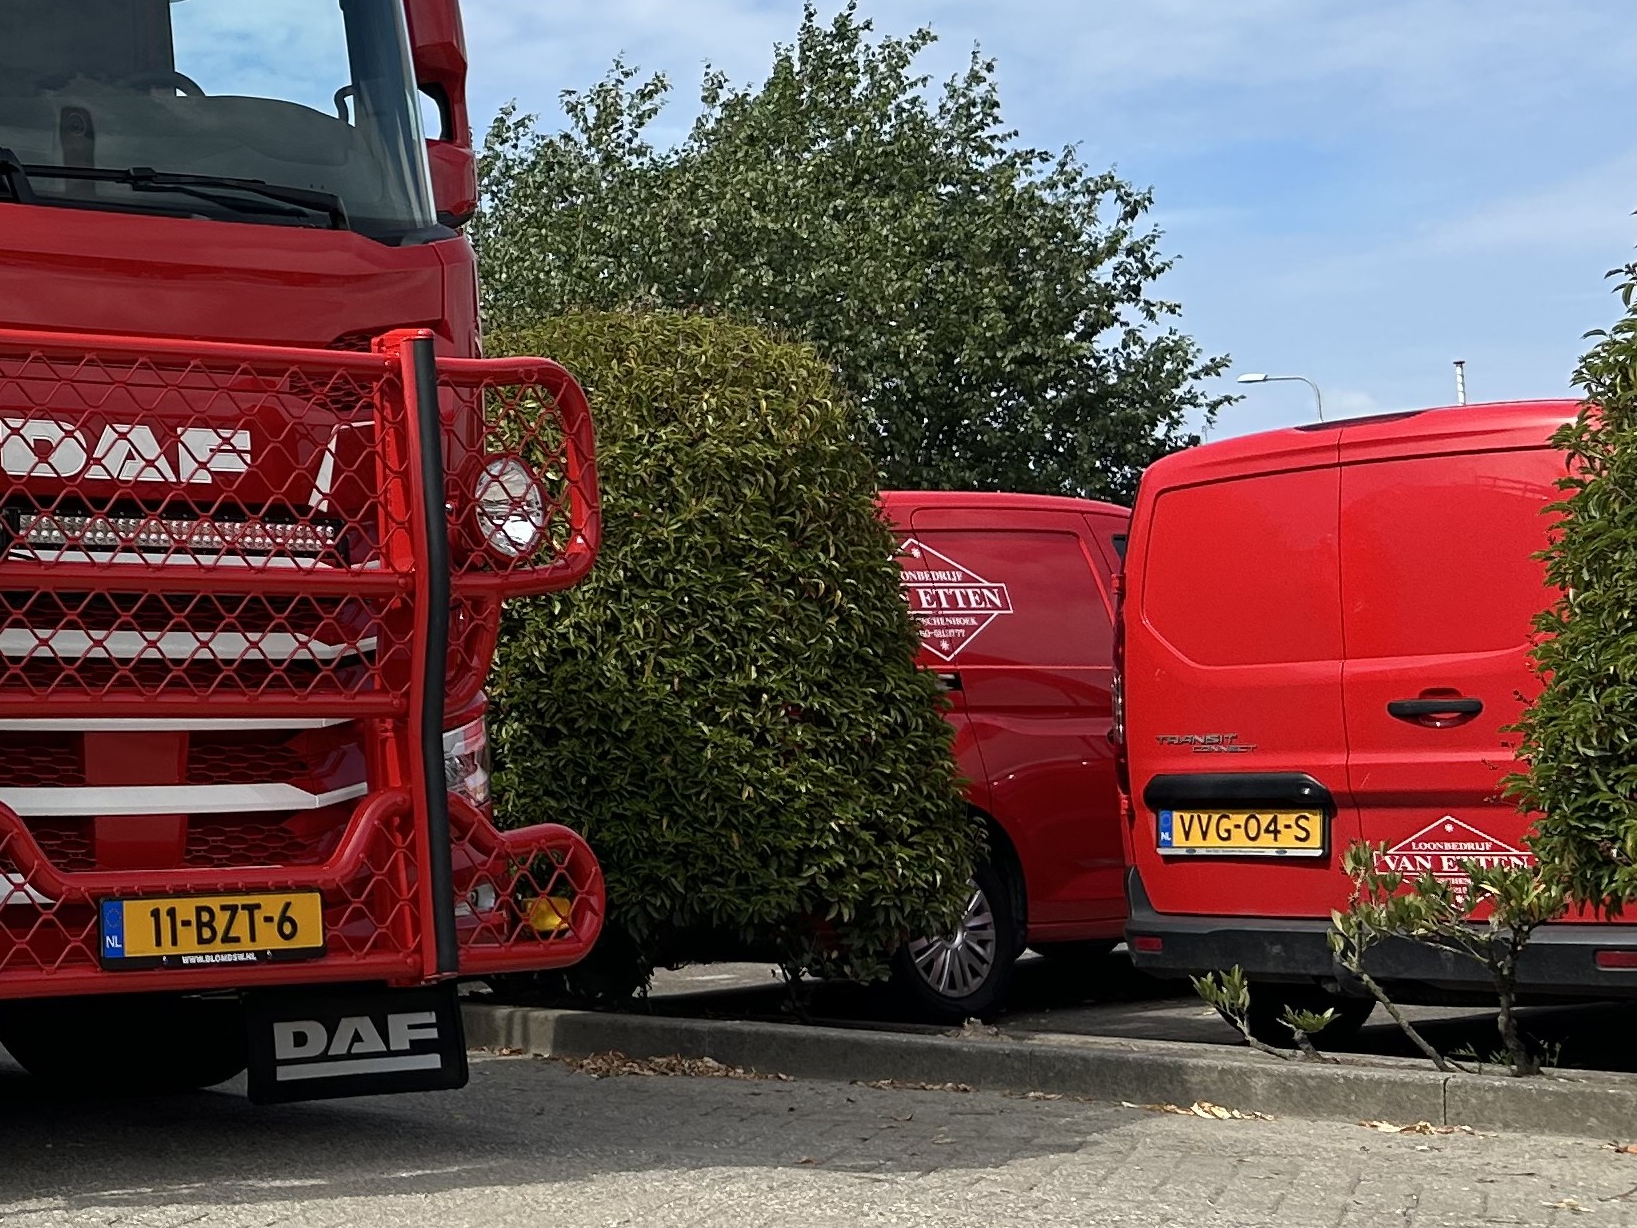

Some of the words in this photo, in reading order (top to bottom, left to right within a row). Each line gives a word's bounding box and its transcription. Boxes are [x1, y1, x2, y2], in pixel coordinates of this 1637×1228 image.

[900, 570, 963, 582] ONBEDRIJF
[916, 588, 1003, 609] ETTEN
[1156, 733, 1238, 746] TRANSIT
[1192, 744, 1258, 754] CONNECT
[1160, 831, 1172, 841] NL
[1179, 813, 1312, 843] VVG-04-S
[1412, 841, 1493, 852] LOONBEDRIJF
[1384, 856, 1432, 872] VAN
[106, 935, 123, 949] NL
[150, 901, 299, 947] 11-BZT-6
[273, 1011, 439, 1060] DAF
